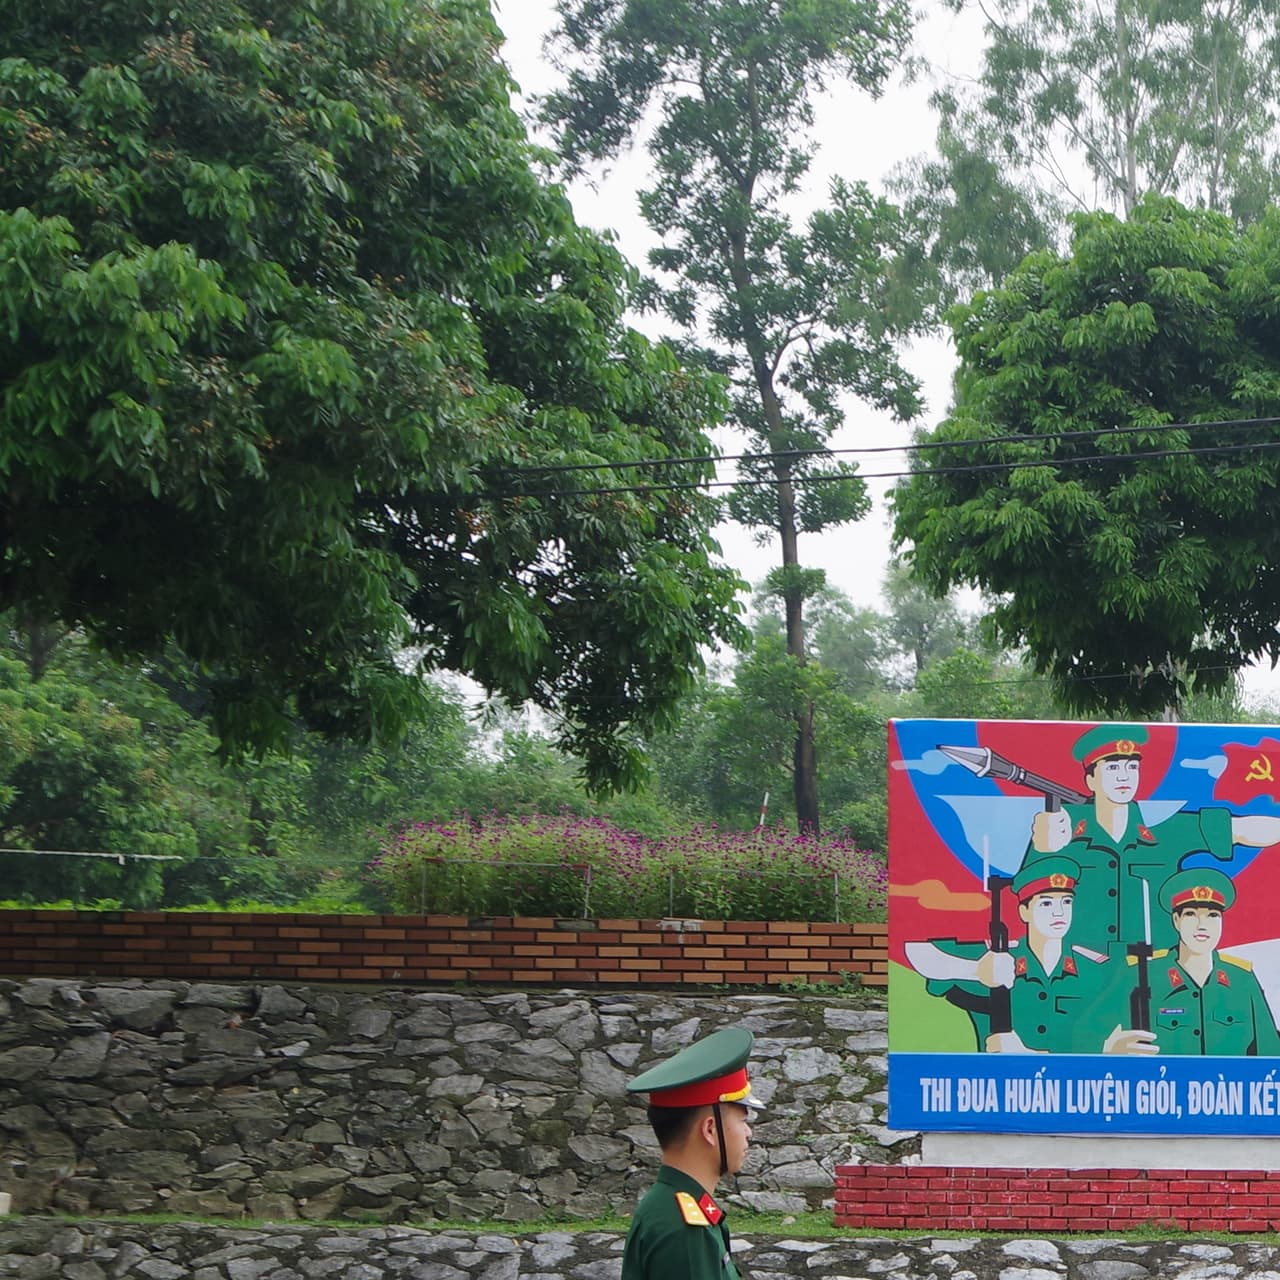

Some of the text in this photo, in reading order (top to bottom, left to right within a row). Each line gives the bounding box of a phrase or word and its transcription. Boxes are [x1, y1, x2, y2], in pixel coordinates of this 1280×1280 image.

[920, 1078, 951, 1112] THI
[957, 1078, 999, 1113] ĐUA
[1005, 1066, 1060, 1113] HUẤN
[1066, 1072, 1130, 1122] LUYỆN
[1136, 1065, 1182, 1119] GIỎI,
[1187, 1073, 1243, 1116] ĐOÀN
